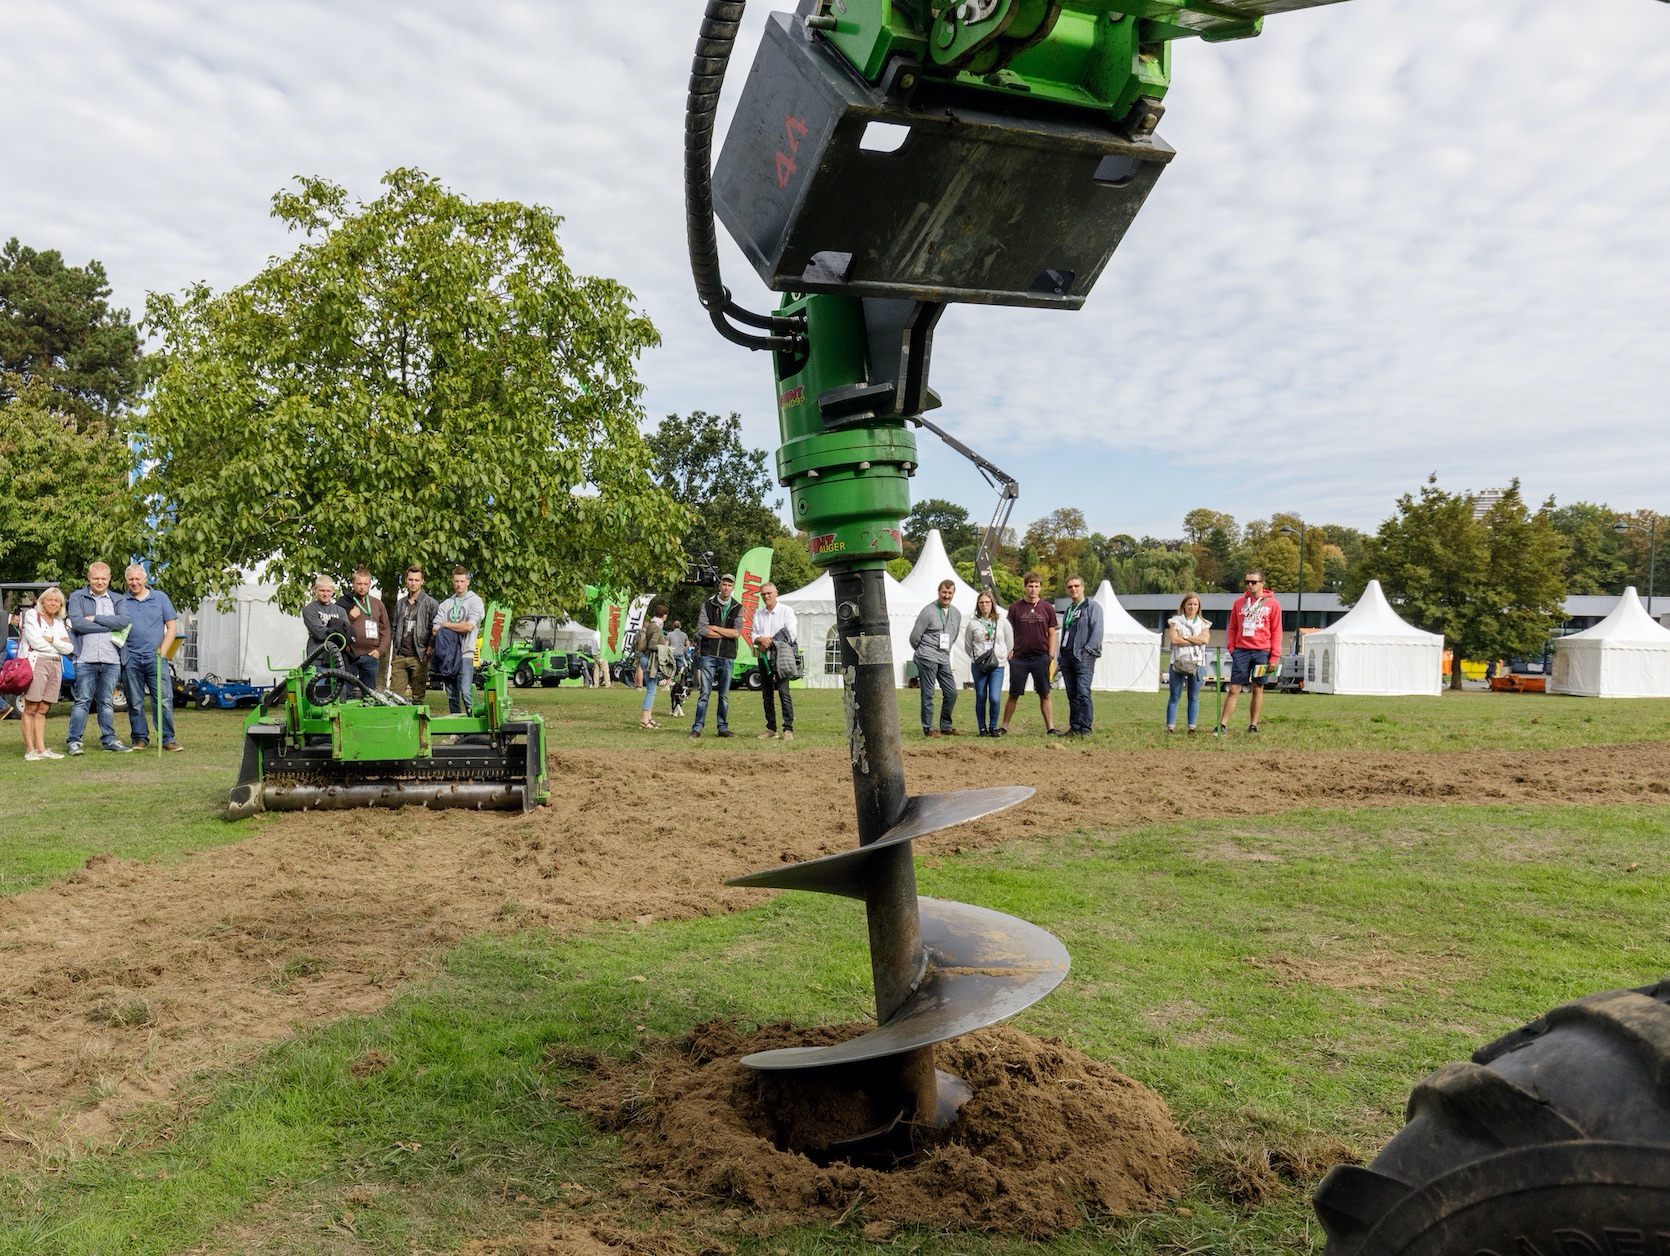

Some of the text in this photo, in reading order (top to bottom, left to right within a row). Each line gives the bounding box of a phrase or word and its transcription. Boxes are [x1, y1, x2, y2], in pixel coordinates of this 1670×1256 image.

[775, 114, 809, 189] 44
[819, 541, 846, 554] AUGER
[489, 610, 506, 653] AVANT
[607, 604, 622, 654] AVANT
[741, 570, 762, 648] AVANT
